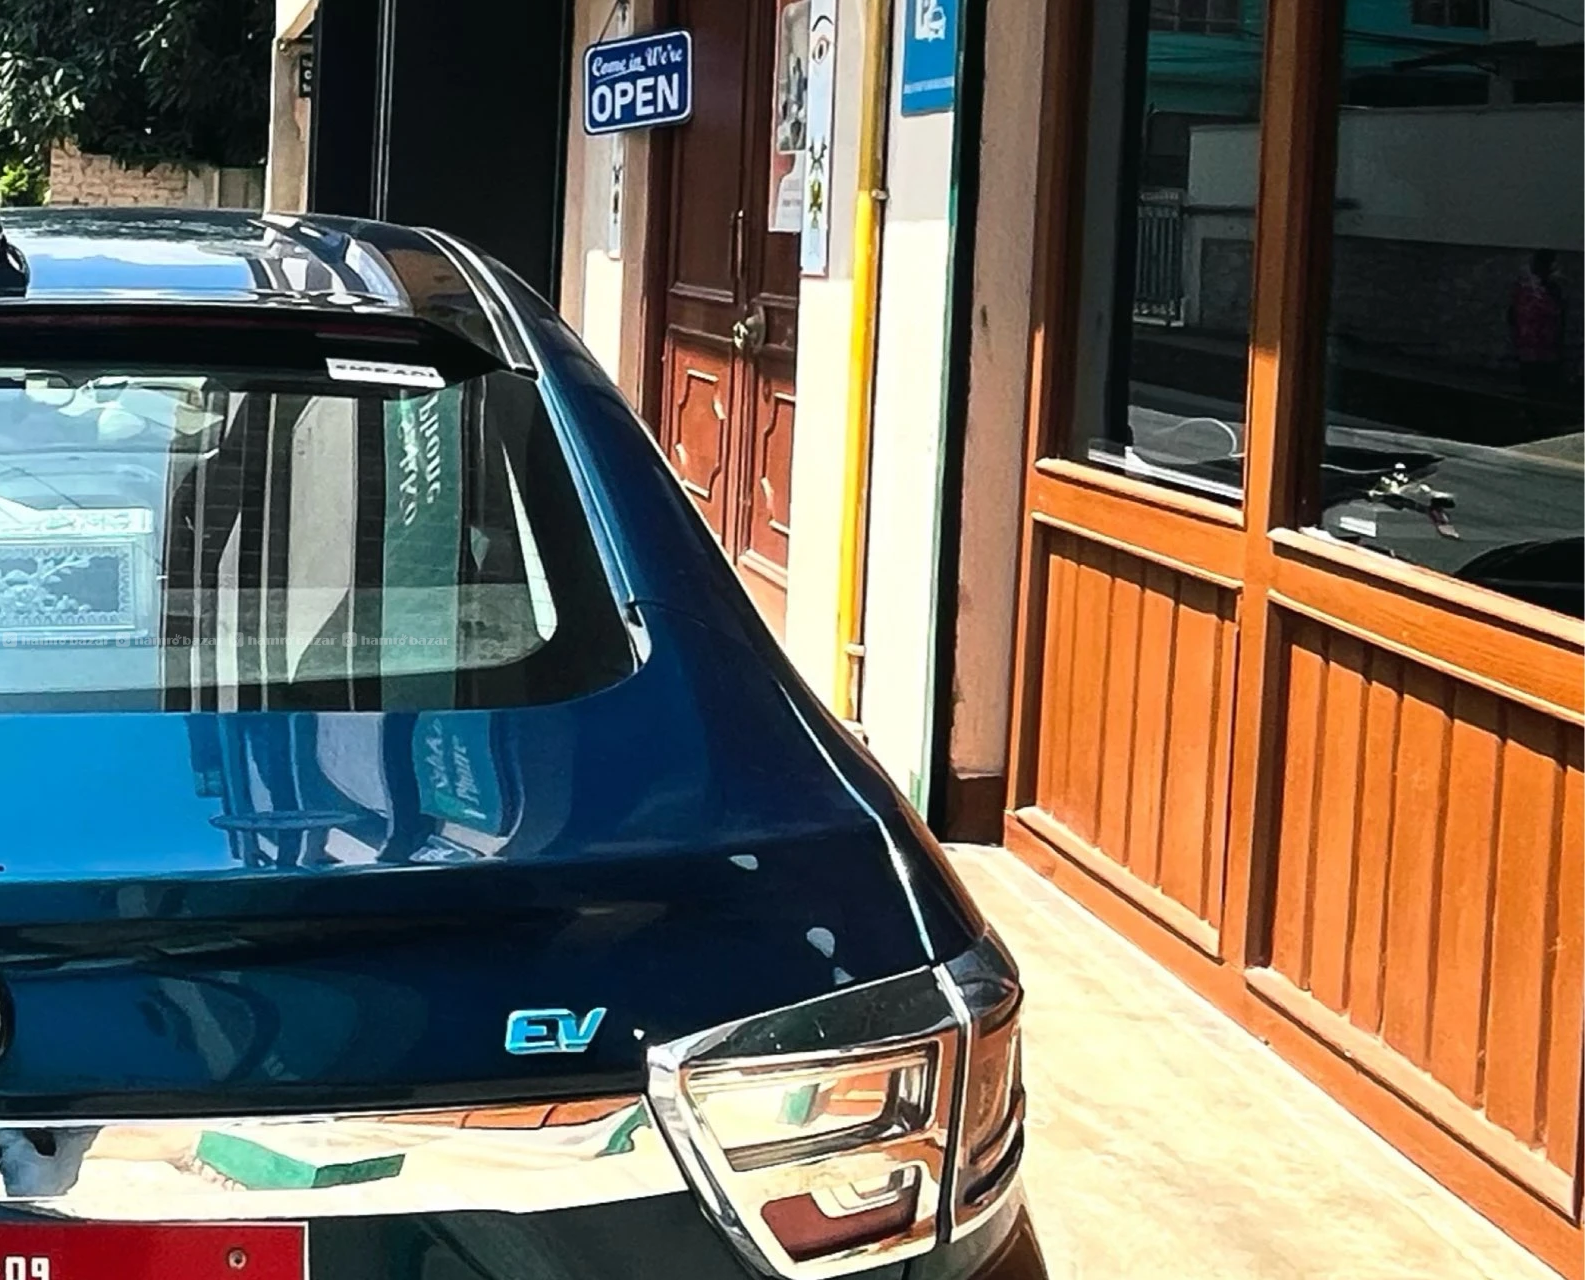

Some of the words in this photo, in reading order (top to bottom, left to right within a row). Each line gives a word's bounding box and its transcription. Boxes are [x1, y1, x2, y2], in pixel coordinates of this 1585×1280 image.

[592, 57, 626, 77] Come
[592, 73, 679, 123] OPEN
[505, 1007, 607, 1055] EV
